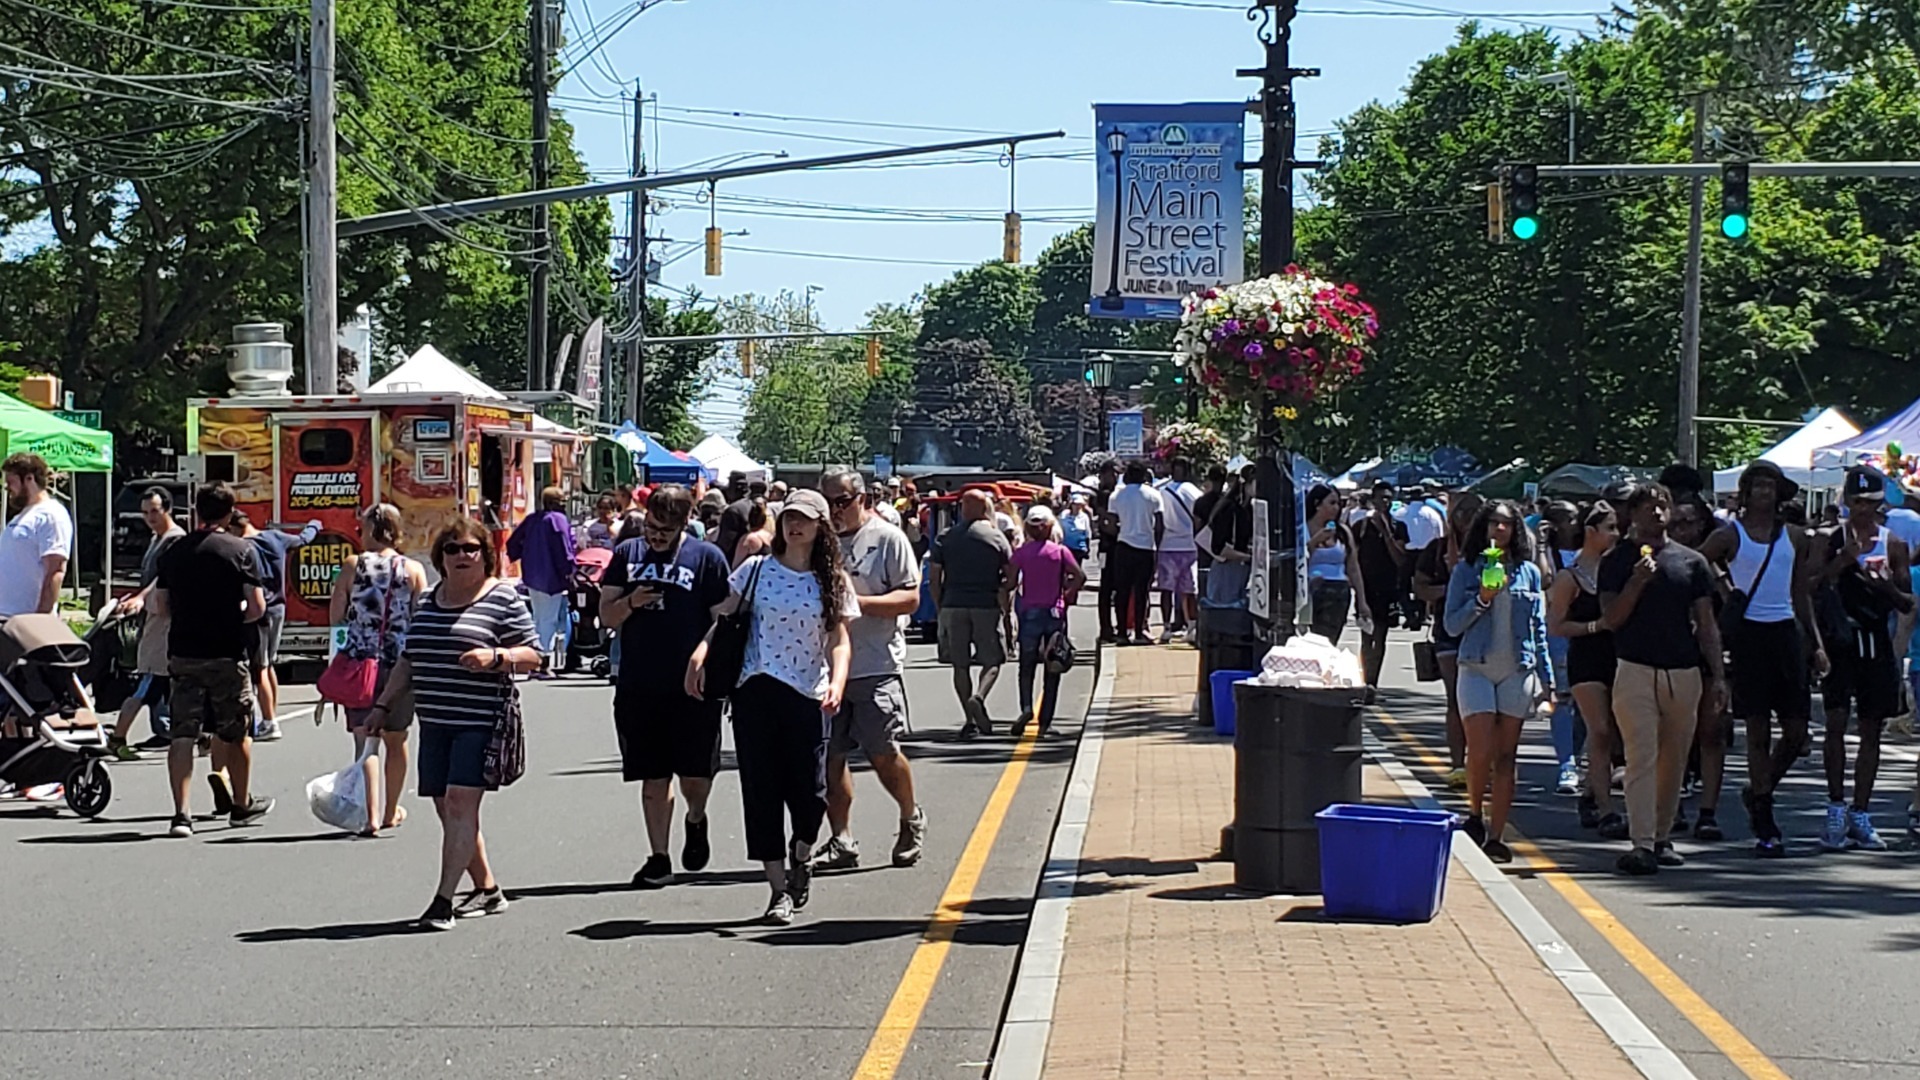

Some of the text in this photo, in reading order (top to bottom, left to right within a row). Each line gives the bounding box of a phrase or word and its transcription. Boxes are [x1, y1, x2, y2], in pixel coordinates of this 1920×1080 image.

[1127, 158, 1221, 181] Stratford
[1128, 181, 1221, 218] Main
[1126, 217, 1227, 249] Street
[1124, 250, 1224, 276] Festival
[1123, 279, 1157, 294] JUNE
[300, 543, 354, 564] FRIED
[626, 562, 695, 592] YALE
